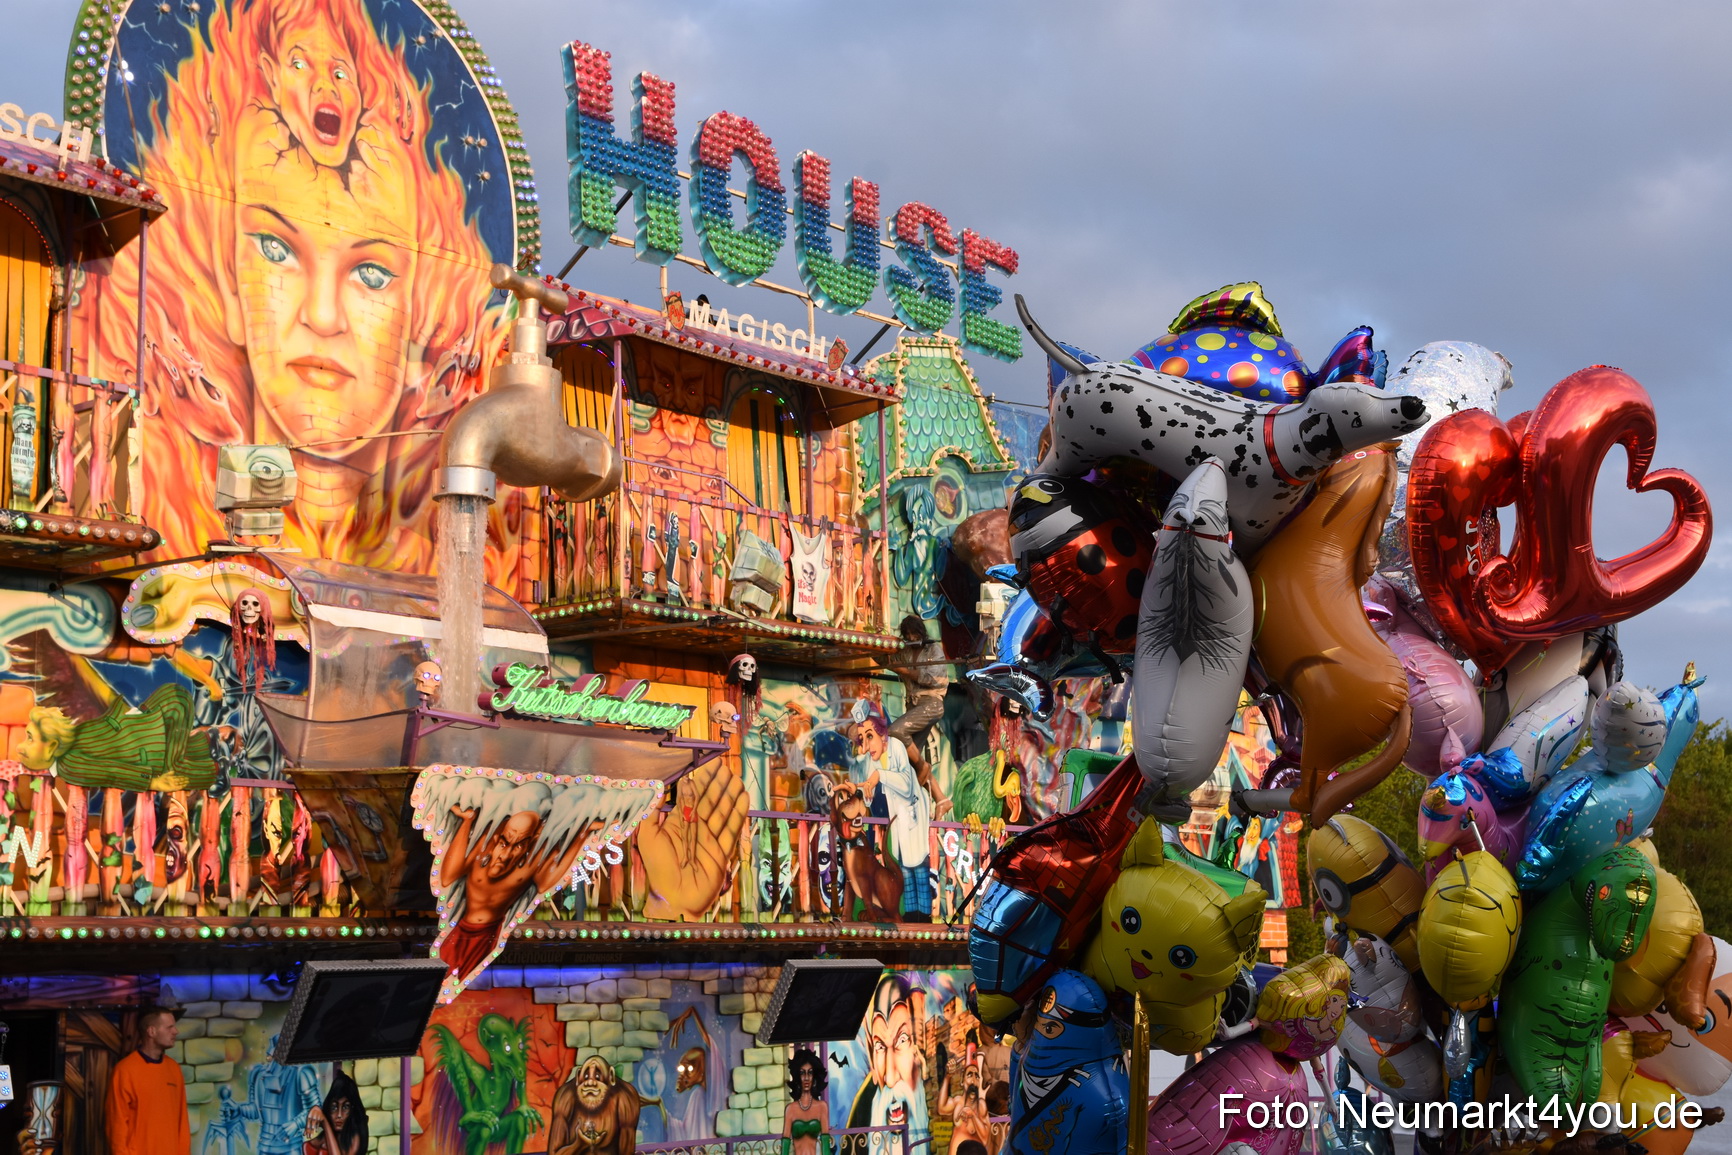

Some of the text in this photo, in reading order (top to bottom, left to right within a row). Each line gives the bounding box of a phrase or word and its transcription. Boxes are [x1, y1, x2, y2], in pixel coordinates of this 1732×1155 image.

[560, 40, 1024, 364] HOUSE
[689, 299, 826, 362] MAGISCH
[798, 591, 817, 605] Magic
[491, 664, 691, 728] Kutschenbauer
[8, 825, 43, 868] N
